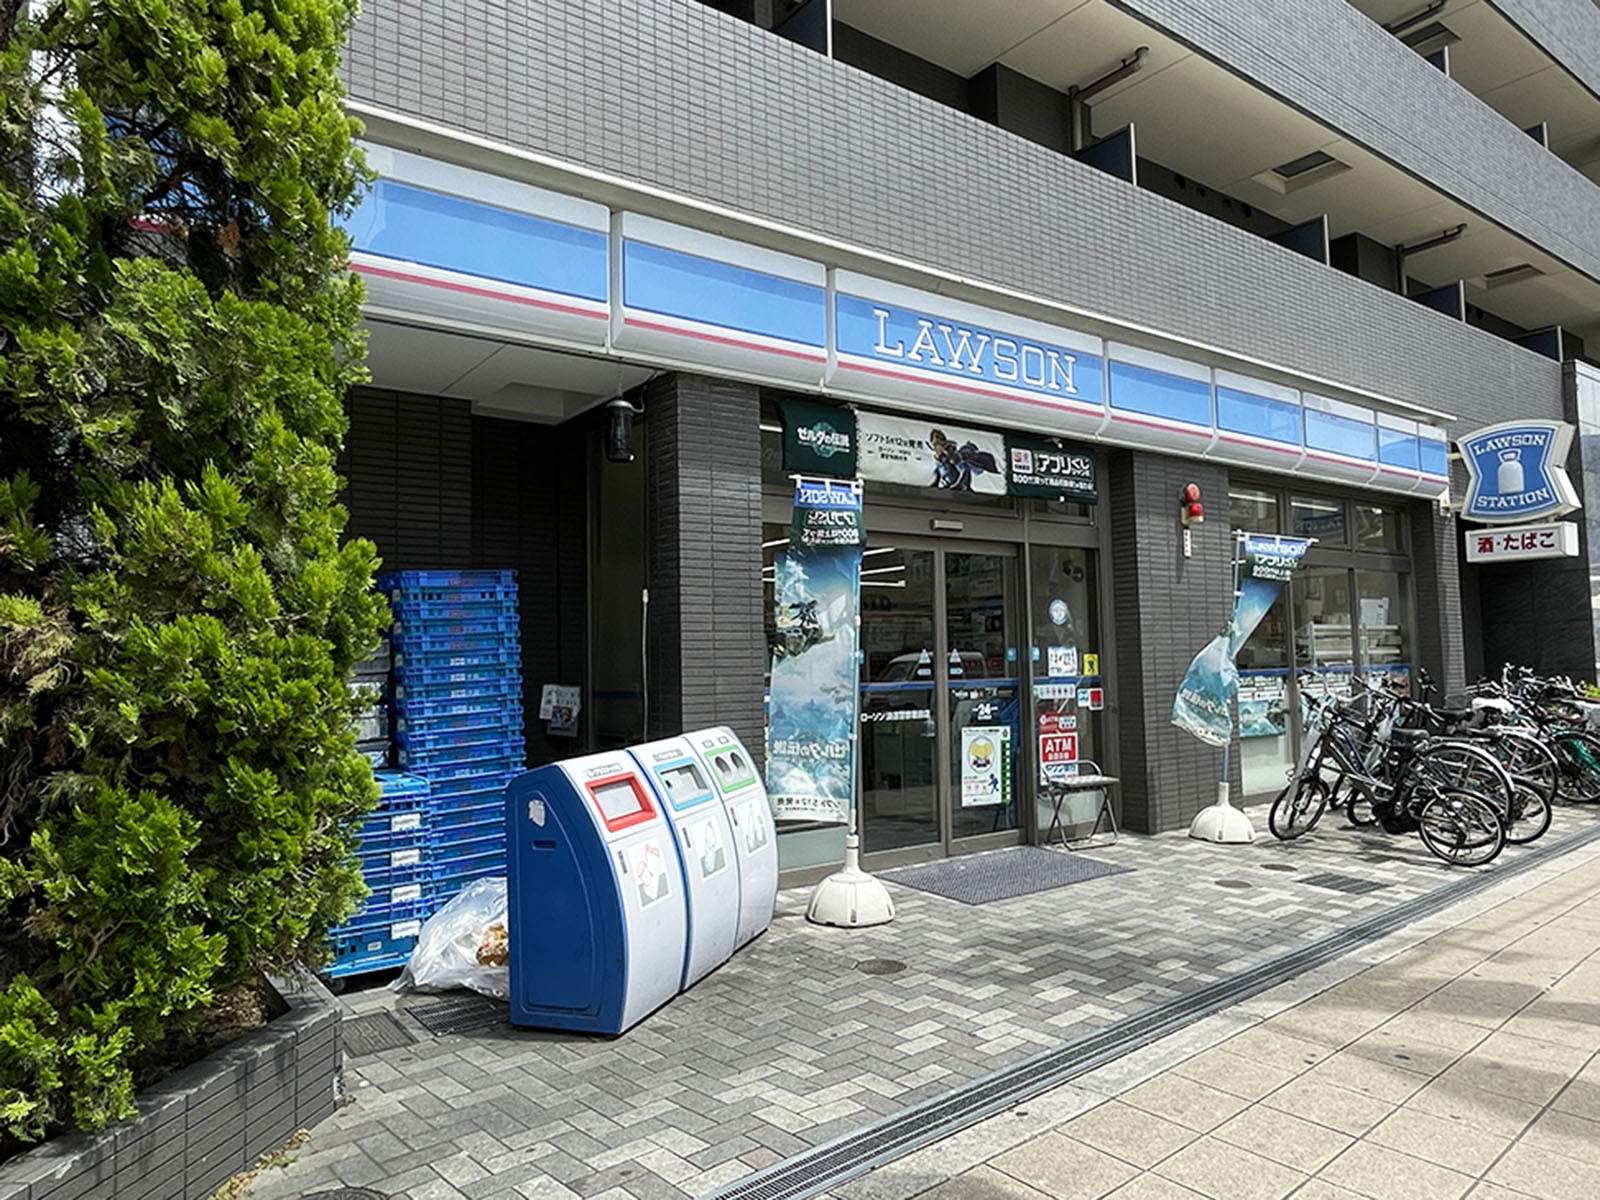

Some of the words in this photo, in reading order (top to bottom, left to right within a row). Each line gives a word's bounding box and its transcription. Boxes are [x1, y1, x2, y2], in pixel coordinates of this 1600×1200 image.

[873, 308, 1078, 394] LAWSON
[1473, 434, 1546, 456] LAWSON
[1477, 488, 1549, 508] STATION
[1478, 531, 1555, 553] 酒・たばこ
[1045, 738, 1072, 753] ATM
